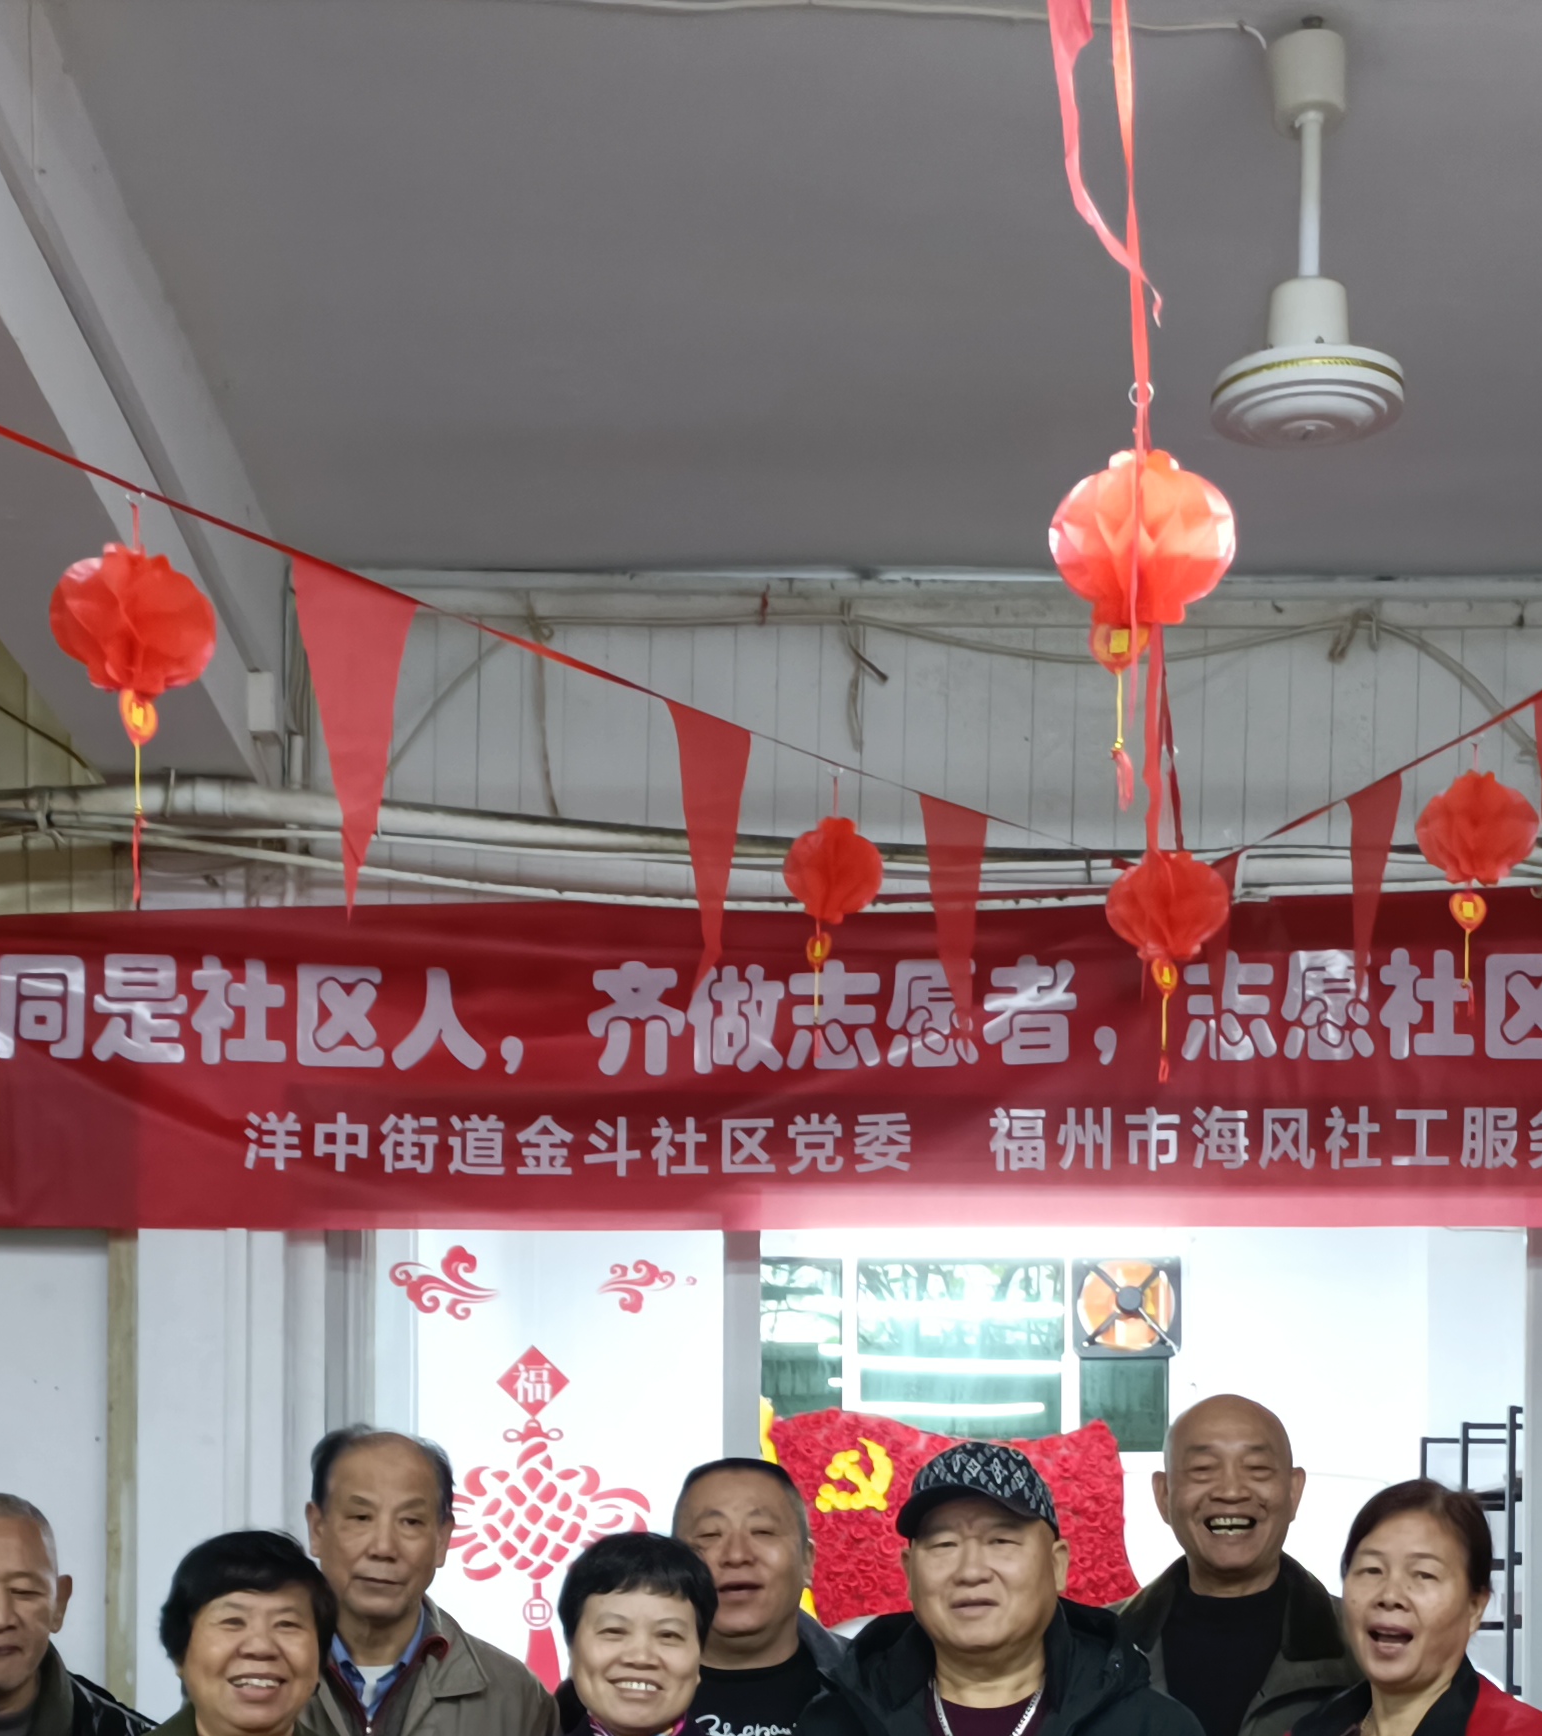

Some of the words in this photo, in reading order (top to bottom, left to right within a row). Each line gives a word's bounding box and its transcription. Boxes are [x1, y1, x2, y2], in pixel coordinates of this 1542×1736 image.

[243, 1110, 913, 1178] 洋中街道金斗社区党委
[511, 1361, 553, 1404] 福
